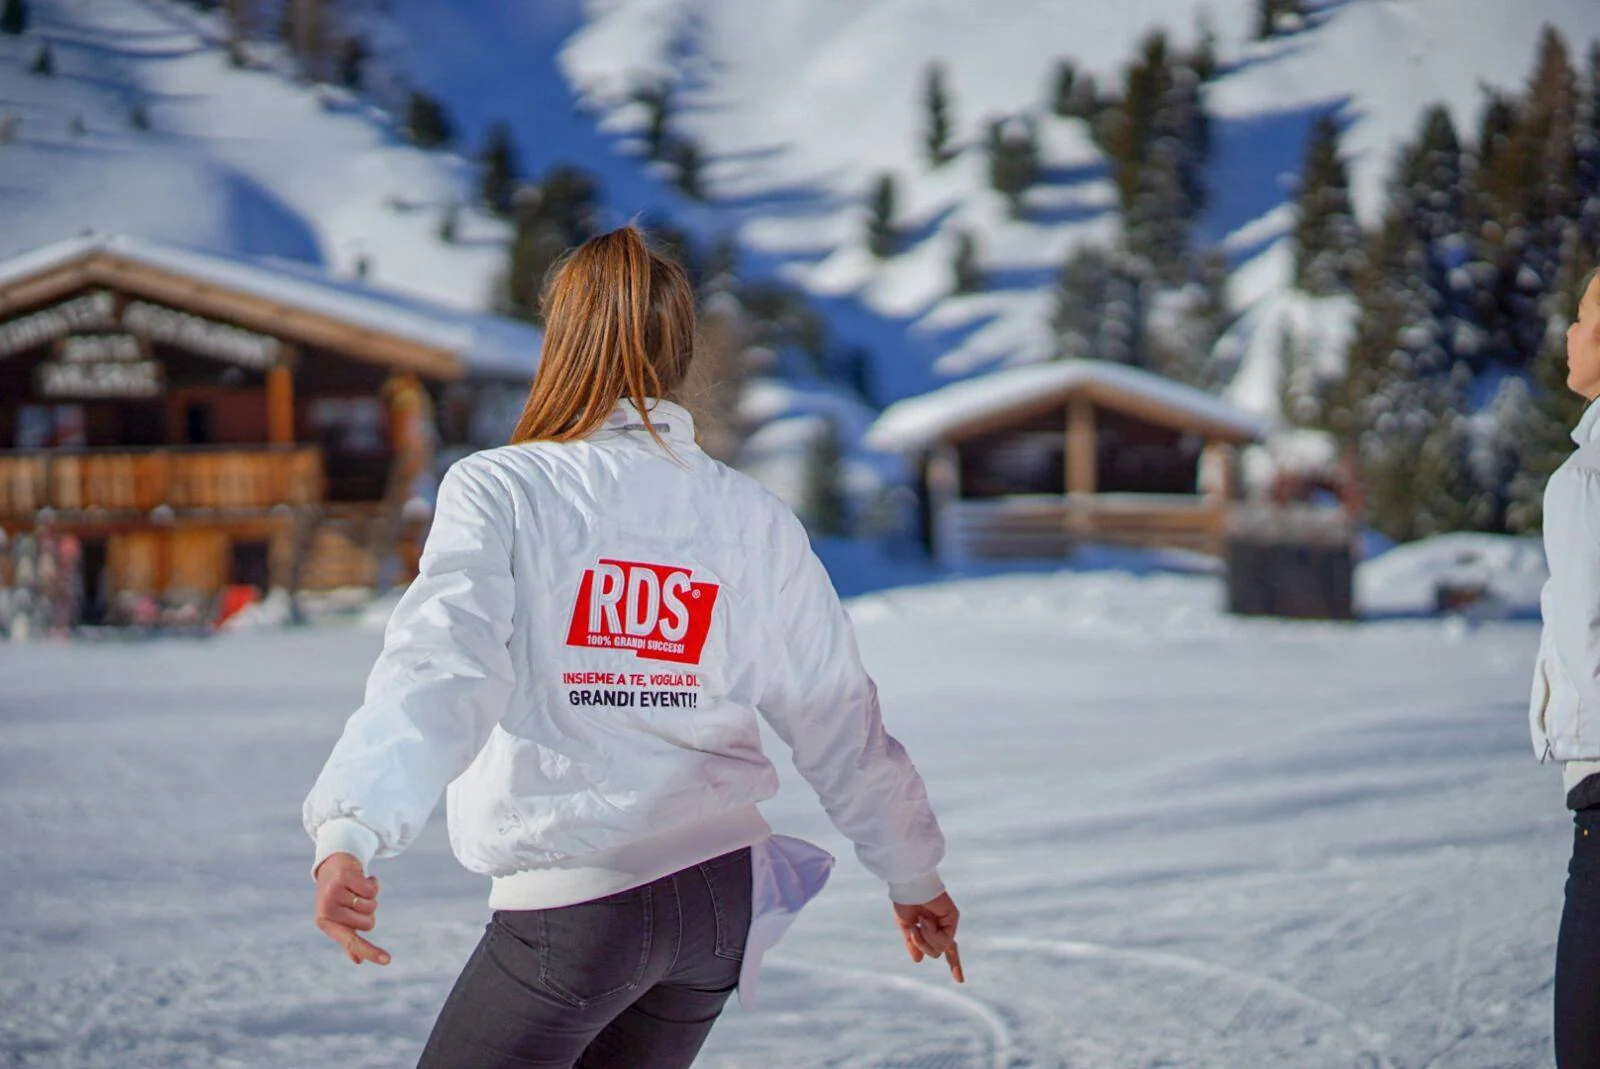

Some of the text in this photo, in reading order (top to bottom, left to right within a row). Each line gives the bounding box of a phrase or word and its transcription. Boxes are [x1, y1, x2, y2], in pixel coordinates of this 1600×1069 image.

[587, 635, 685, 654] 100% GRANDI SUCCESSI
[563, 672, 615, 684] INSIEME
[616, 673, 627, 685] A
[629, 674, 647, 687] TE,
[650, 674, 684, 686] VOGLIA
[569, 690, 697, 708] GRANDI EVENTI!
